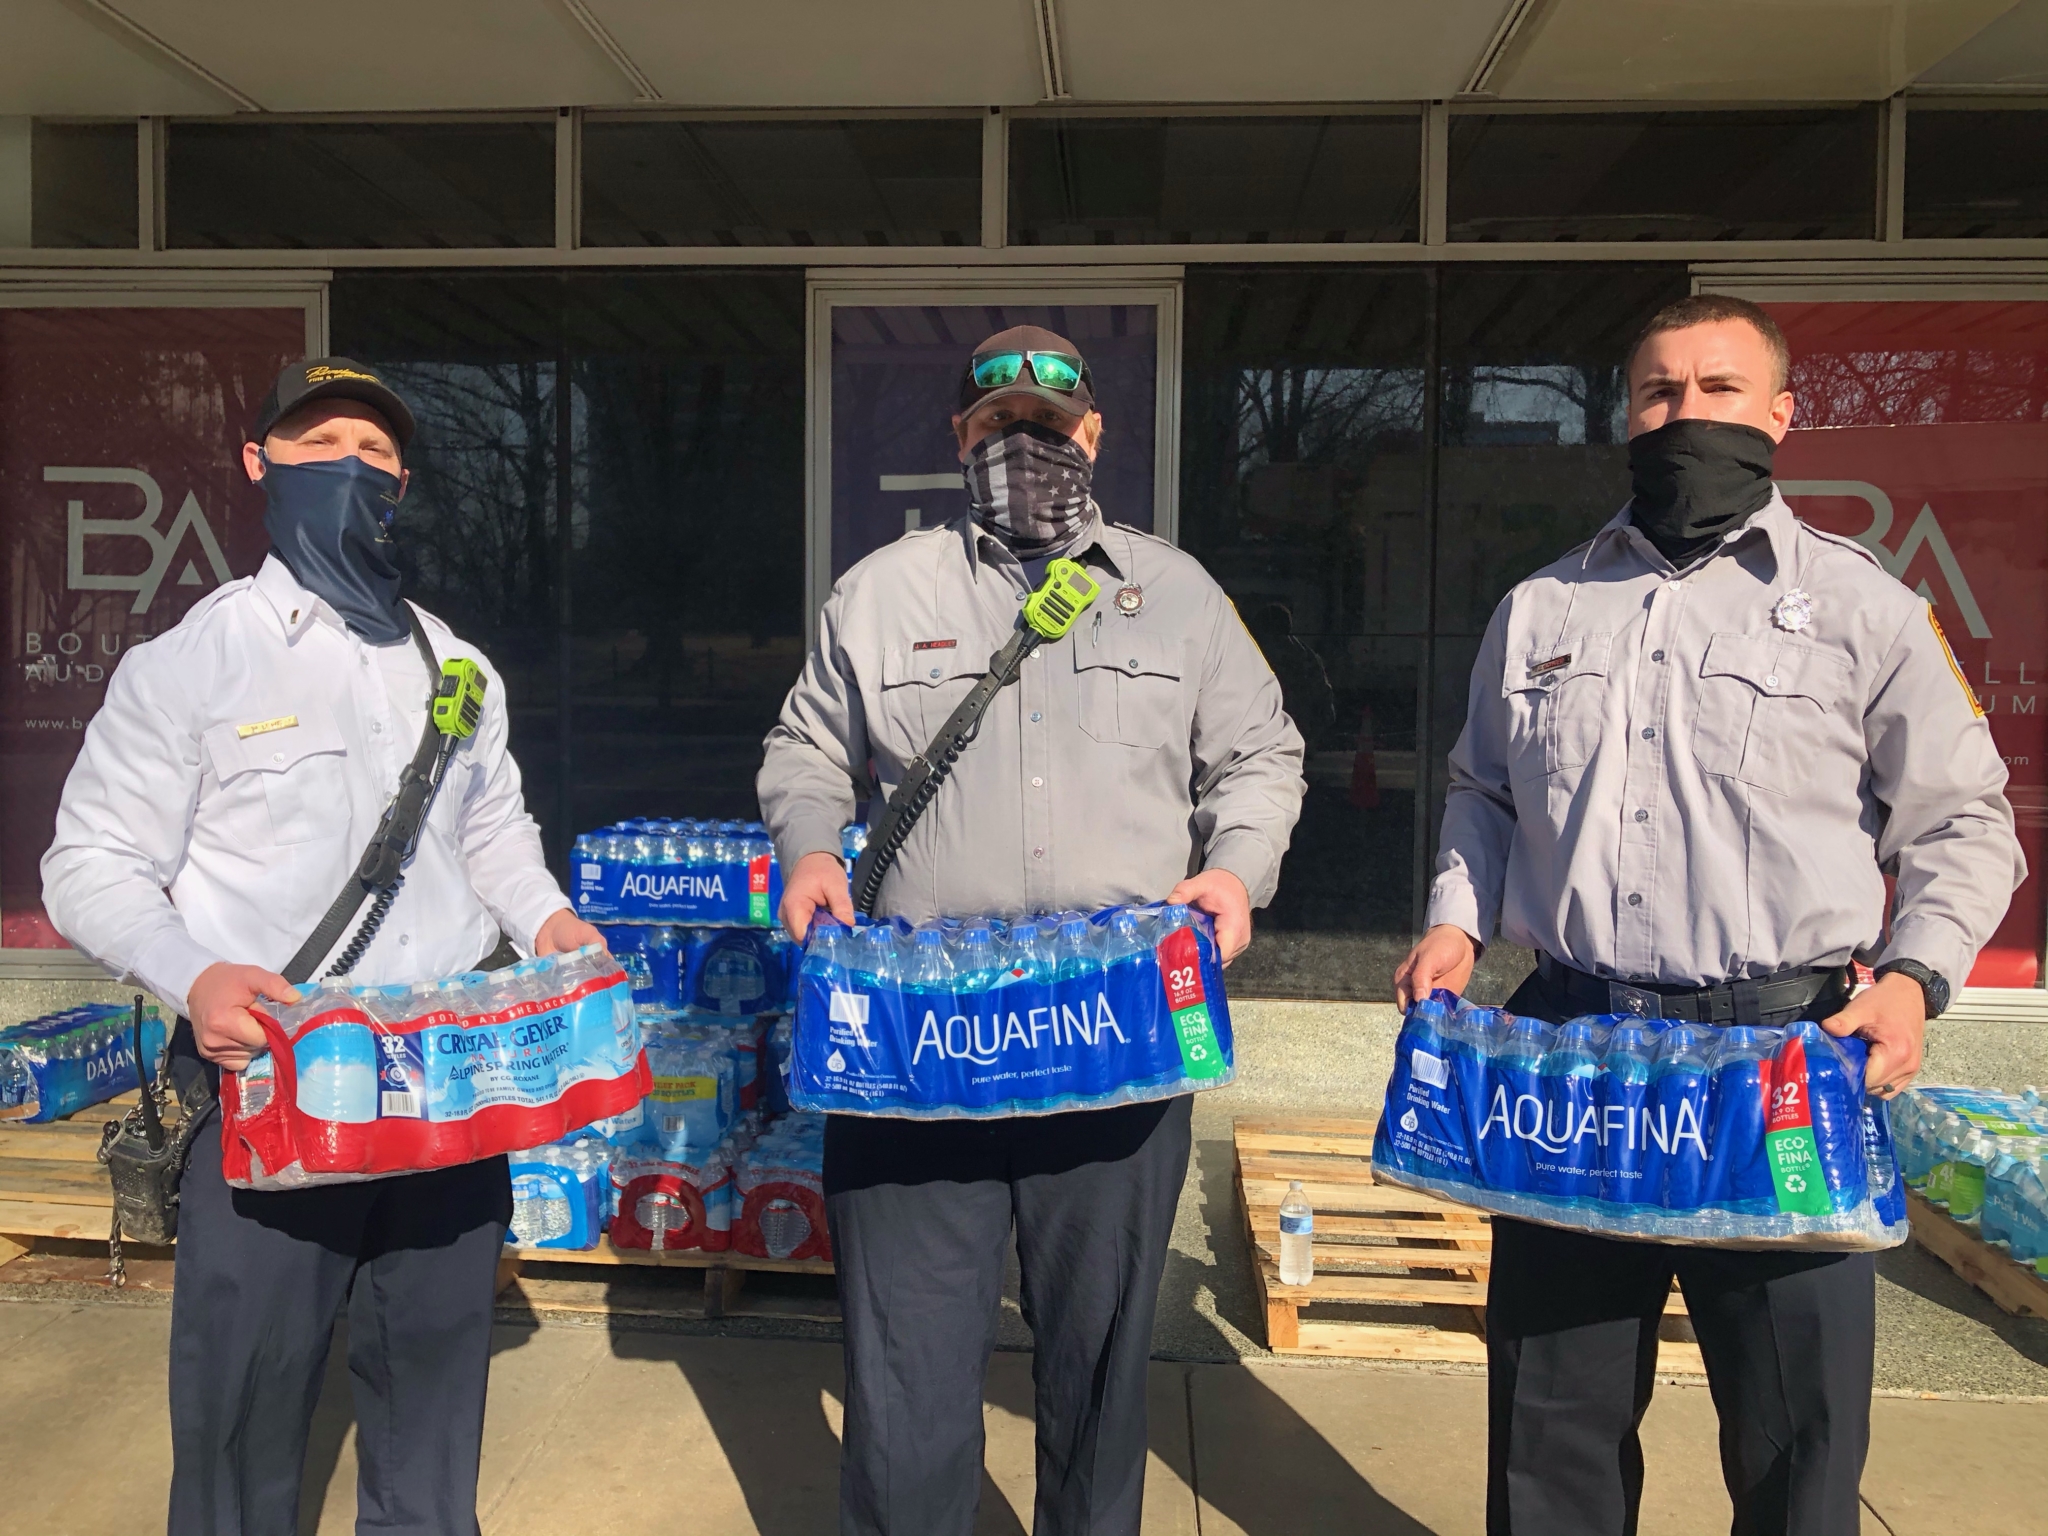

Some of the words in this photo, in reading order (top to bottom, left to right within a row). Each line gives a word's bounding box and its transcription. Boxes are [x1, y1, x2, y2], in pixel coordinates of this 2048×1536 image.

[620, 871, 726, 901] AQUAFINA
[752, 873, 766, 885] 32
[1169, 966, 1197, 991] 32
[1173, 989, 1184, 998] 16.9
[1175, 993, 1197, 1004] BOTTLES
[479, 1015, 498, 1024] AT
[436, 1031, 507, 1055] CRYSTAL
[509, 1015, 569, 1048] GEYSER
[829, 1026, 854, 1037] Purified
[912, 991, 1125, 1066] AQUAFINA
[1182, 1023, 1209, 1038] FINA
[381, 1035, 406, 1054] 32
[829, 1034, 856, 1048] Drinking
[469, 1043, 551, 1062] NATURAL
[486, 1057, 541, 1073] SPRING
[542, 1044, 569, 1067] WATER
[86, 1046, 136, 1082] DASAN
[489, 1074, 499, 1083] BY
[513, 1074, 540, 1083] ROXANE
[971, 1076, 991, 1086] pure
[992, 1071, 1019, 1082] water,
[1020, 1067, 1050, 1080] perfect
[1051, 1064, 1073, 1074] taste
[1408, 1083, 1430, 1098] Purified
[1771, 1082, 1801, 1109] 32
[491, 1095, 516, 1104] BOTTLES
[517, 1096, 535, 1104] TOTAL
[1406, 1092, 1430, 1109] Drinking
[1431, 1100, 1451, 1115] Water
[1478, 1083, 1708, 1161] AQUAFINA
[1772, 1113, 1799, 1124] BOTTLES
[1774, 1136, 1809, 1152] ECO-
[1777, 1150, 1813, 1165] FINA
[1535, 1162, 1556, 1171] pure
[1557, 1165, 1587, 1177] water,
[1589, 1168, 1618, 1178] perfect
[1619, 1169, 1643, 1179] taste
